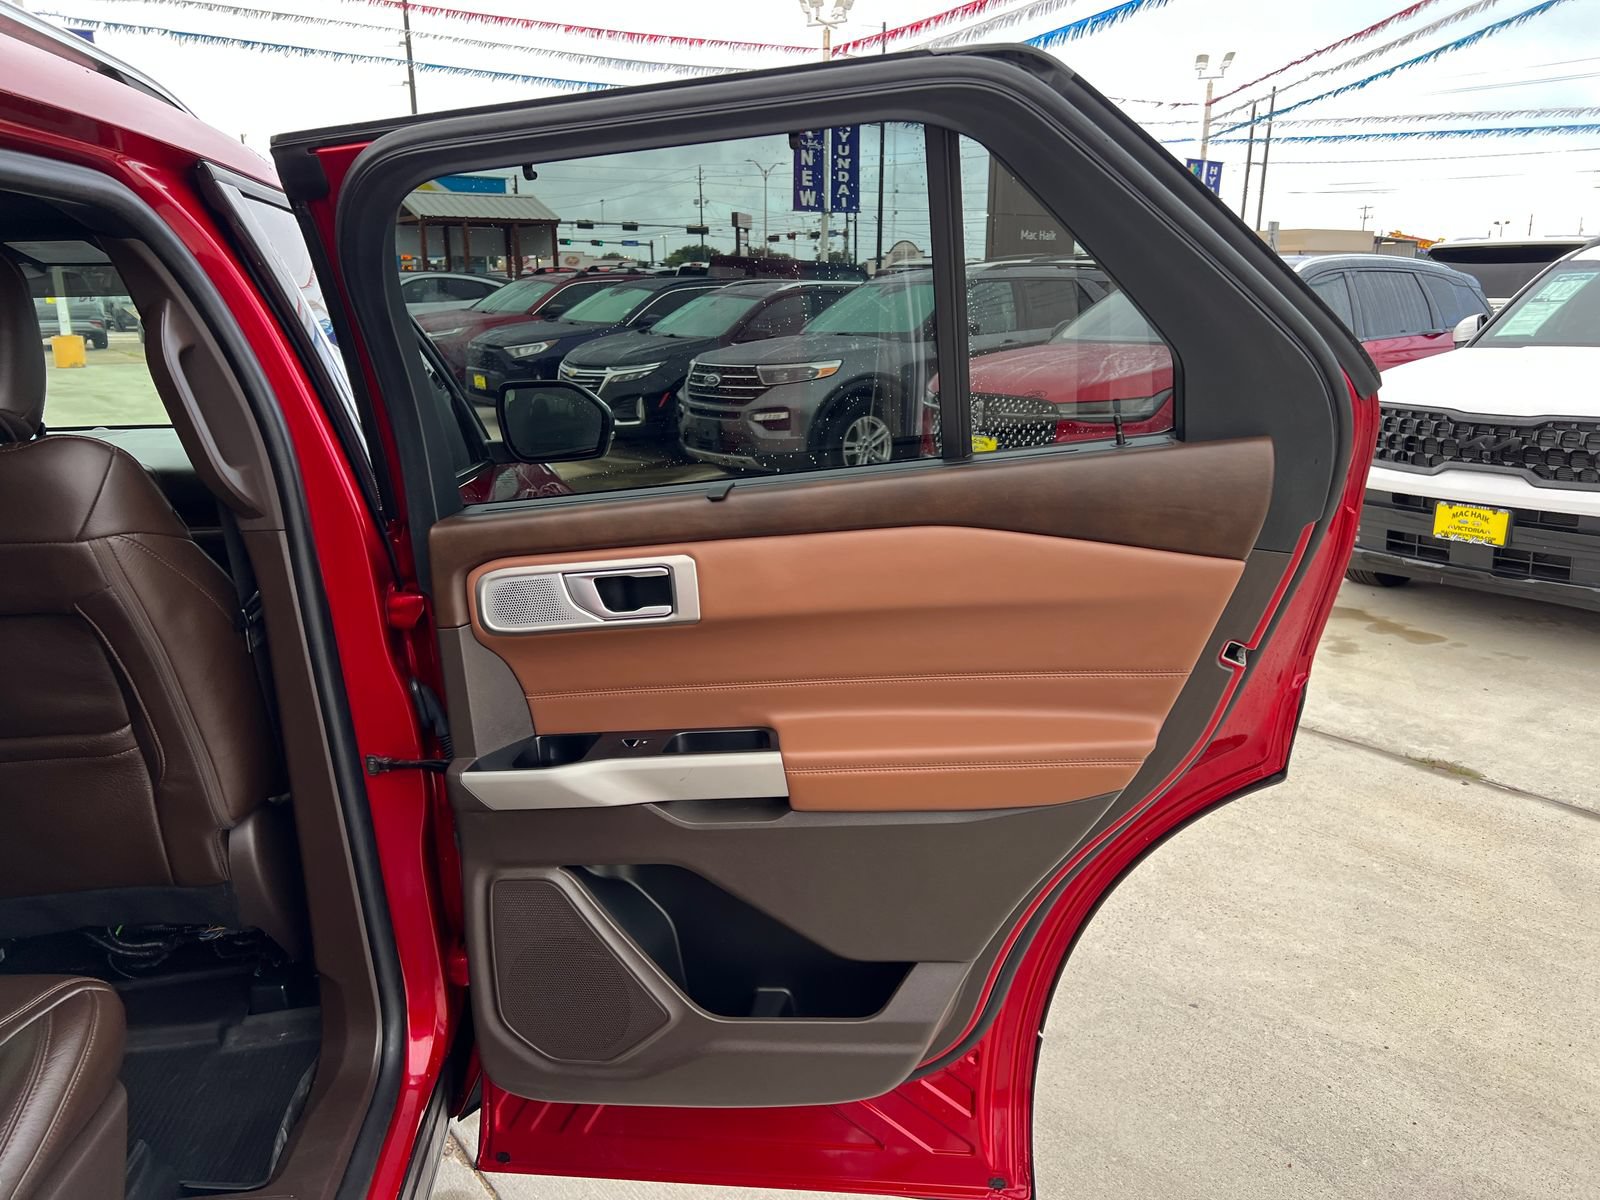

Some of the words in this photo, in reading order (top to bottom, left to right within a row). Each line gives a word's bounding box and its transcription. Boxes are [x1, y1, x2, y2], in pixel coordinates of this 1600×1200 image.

[837, 127, 852, 208] YUNDAI
[799, 149, 817, 207] NEW
[1020, 229, 1038, 241] Mac
[1451, 510, 1470, 520] MAC
[1470, 510, 1490, 524] HAIK
[1454, 525, 1485, 534] VICTORIA
